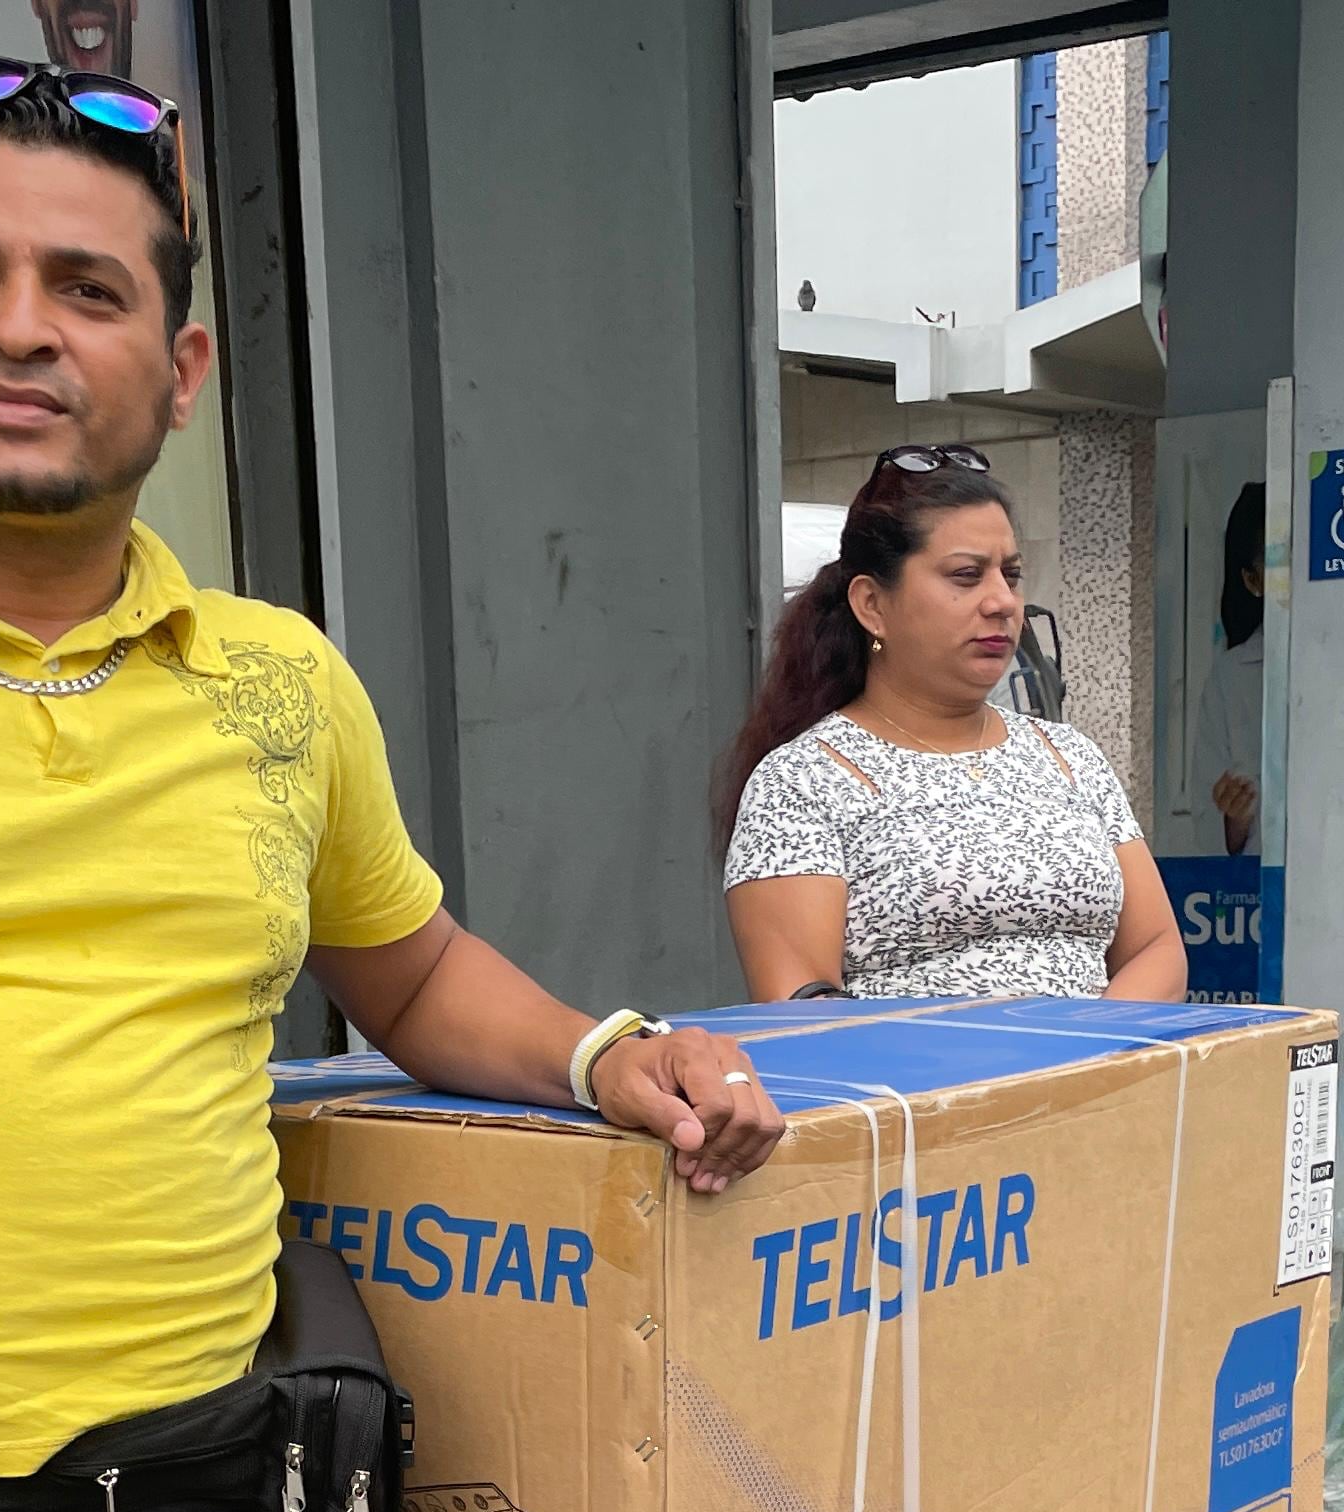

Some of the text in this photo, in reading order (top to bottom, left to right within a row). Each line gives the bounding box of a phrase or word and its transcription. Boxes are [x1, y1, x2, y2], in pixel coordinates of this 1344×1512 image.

[1183, 892, 1262, 944] Suc
[1296, 1043, 1333, 1068] TELSTAR
[288, 1200, 594, 1308] TELSTAR
[752, 1173, 1036, 1341] TELSTAR
[1234, 1381, 1275, 1409] Lavadora
[1219, 1427, 1284, 1469] TLS017630CF
